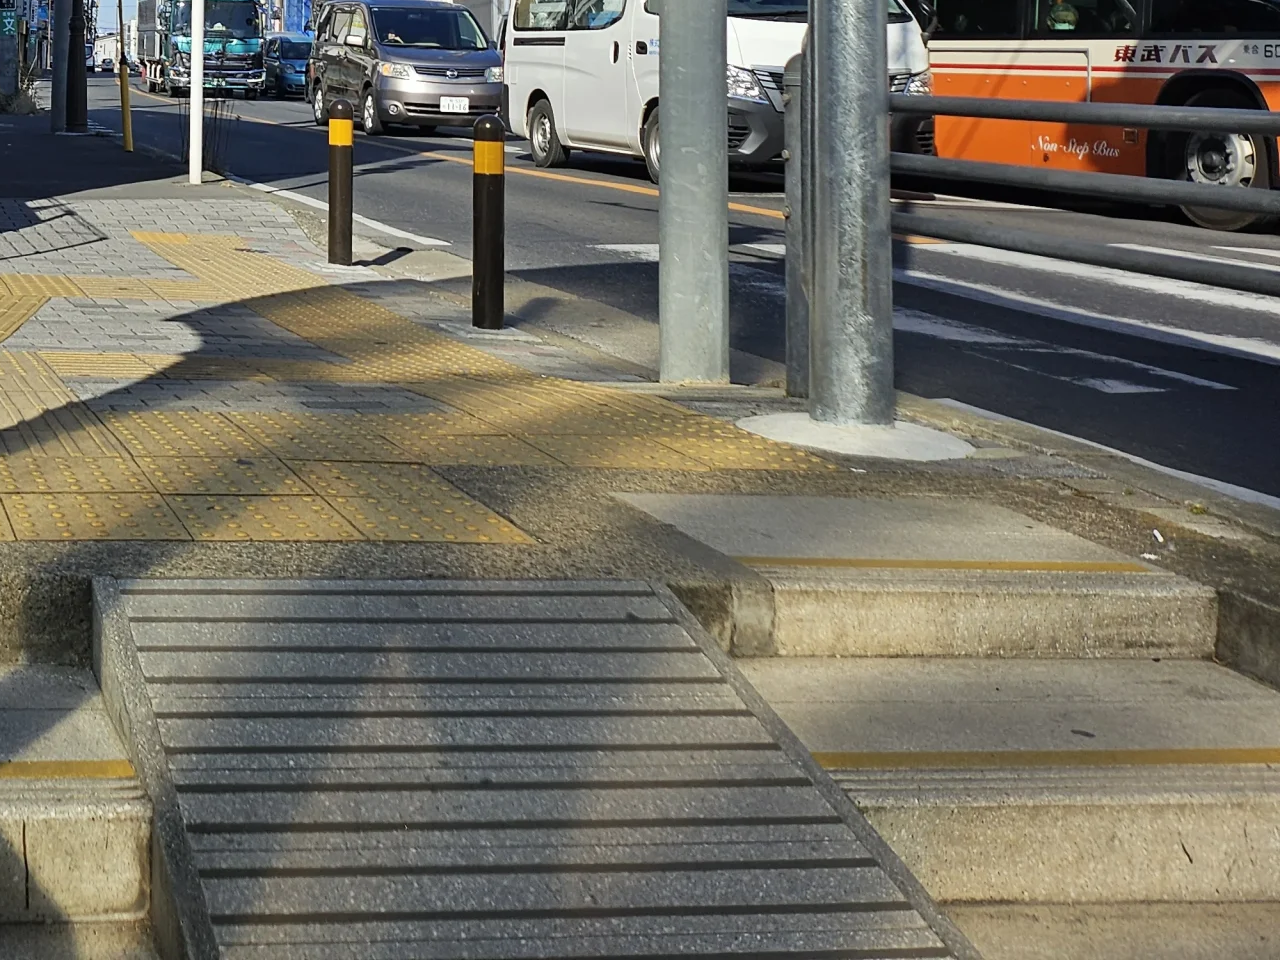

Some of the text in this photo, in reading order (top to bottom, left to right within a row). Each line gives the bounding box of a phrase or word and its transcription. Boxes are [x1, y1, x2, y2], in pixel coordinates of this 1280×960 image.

[3, 17, 16, 31] 文
[1113, 44, 1219, 64] 東武バス
[1031, 135, 1120, 160] Non-Step Bus
